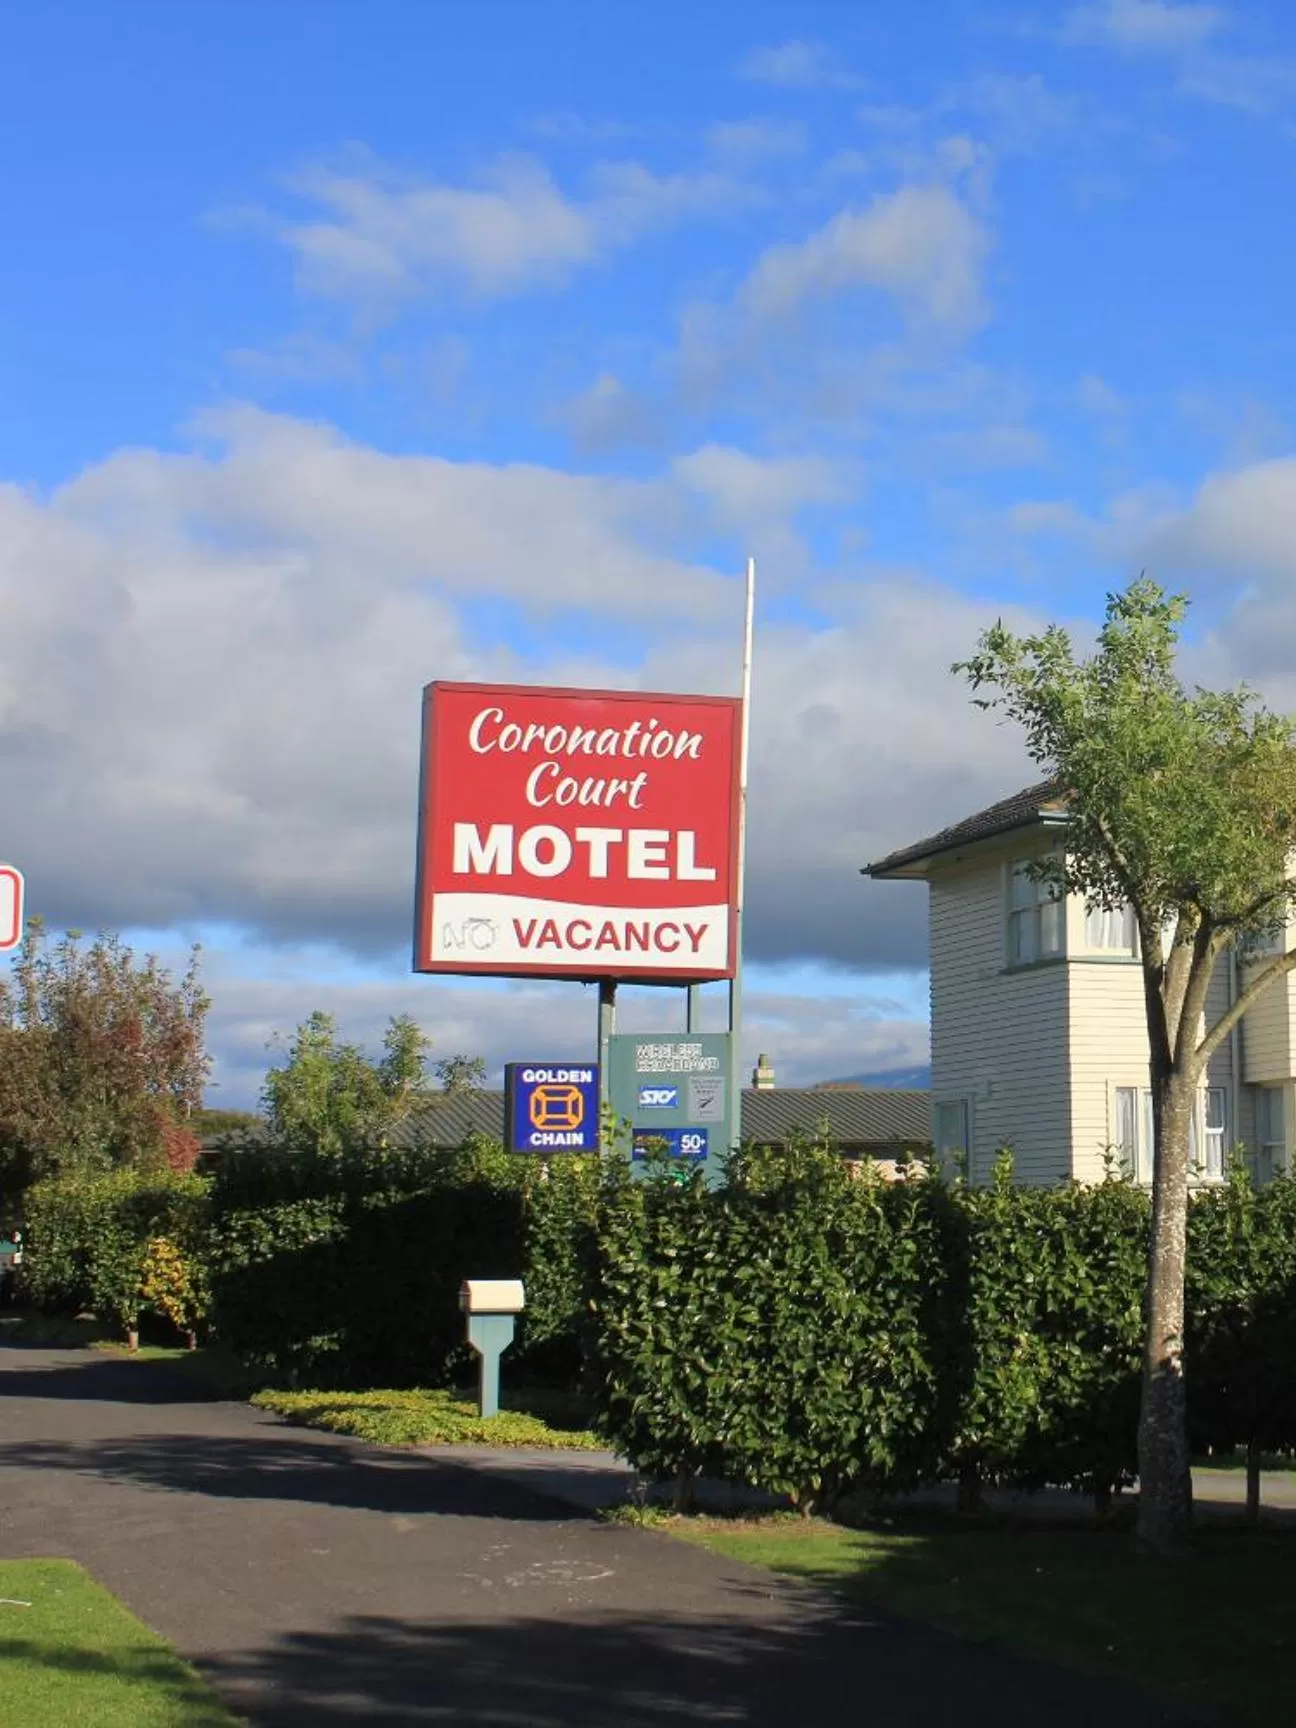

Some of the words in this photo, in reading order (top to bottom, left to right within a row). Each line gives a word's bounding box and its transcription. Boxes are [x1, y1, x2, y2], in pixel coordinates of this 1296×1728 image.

[469, 707, 703, 759] Coronation
[526, 761, 648, 809] Court
[452, 822, 716, 881] MOTEL
[512, 918, 709, 953] VACANCY
[522, 1069, 592, 1083] GOLDEN
[530, 1132, 583, 1146] CHAIN
